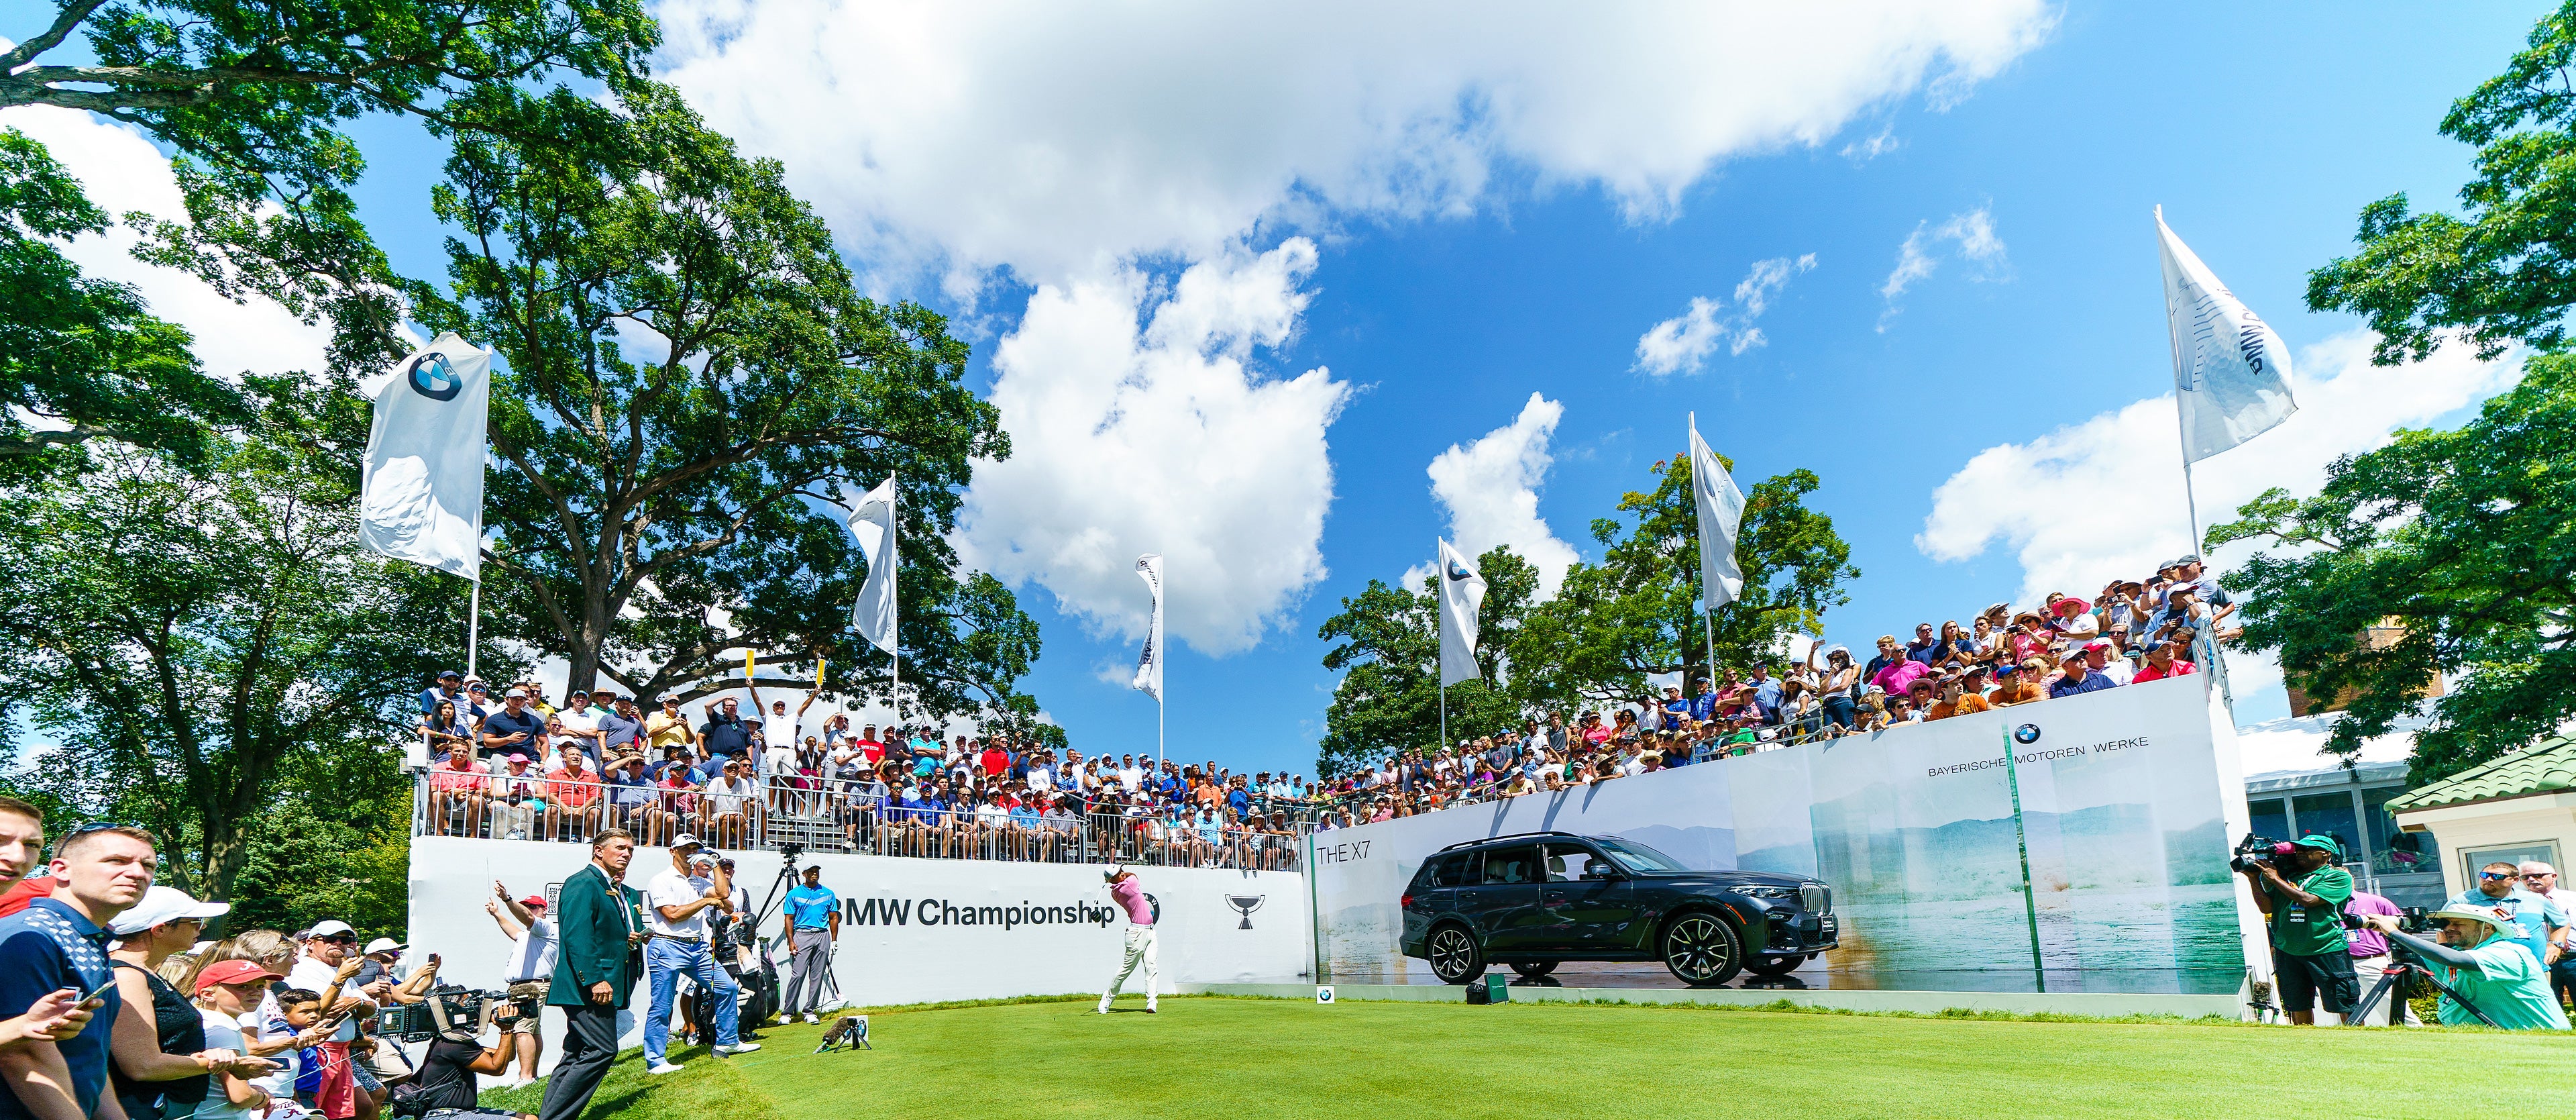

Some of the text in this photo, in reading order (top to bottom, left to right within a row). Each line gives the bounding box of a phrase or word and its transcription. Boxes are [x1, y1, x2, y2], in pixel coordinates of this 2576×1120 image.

[1928, 736, 2149, 777] BAYERISCHE MOTOREN WERKE
[1316, 839, 1371, 865] THE X7
[548, 891, 557, 913] TOUR
[837, 898, 912, 926] MW
